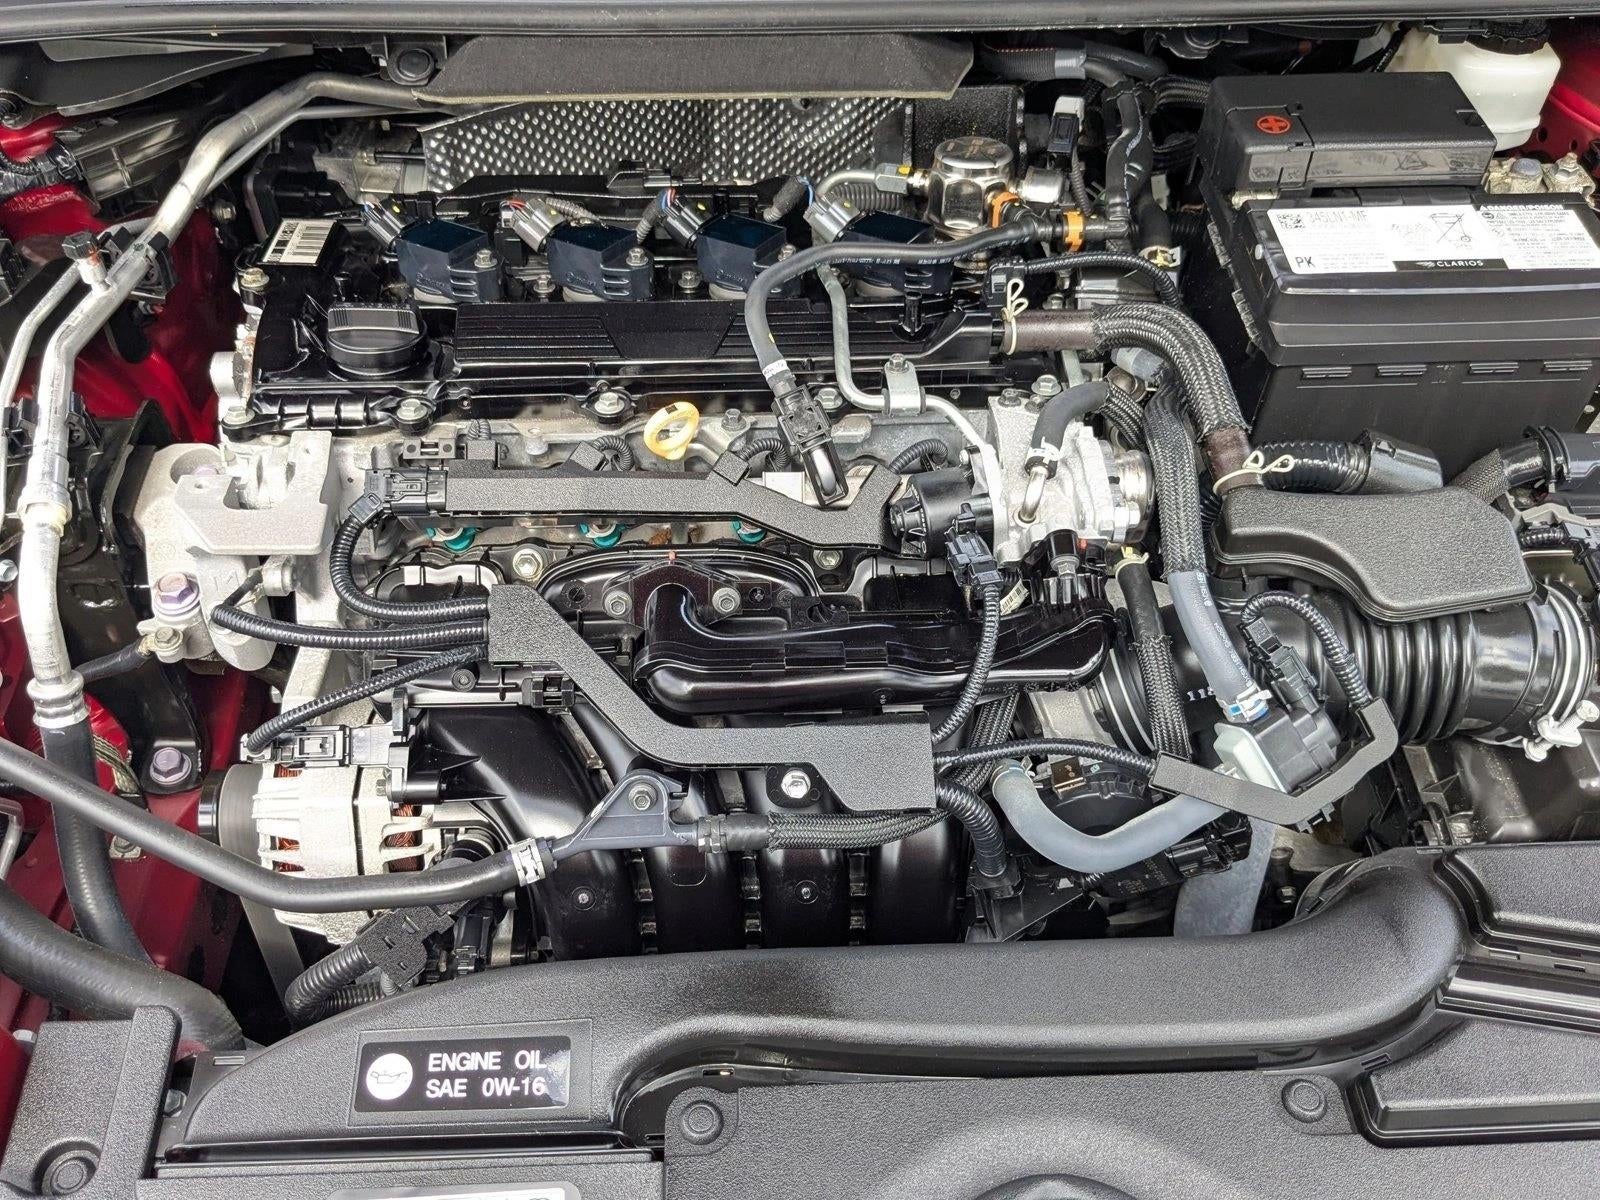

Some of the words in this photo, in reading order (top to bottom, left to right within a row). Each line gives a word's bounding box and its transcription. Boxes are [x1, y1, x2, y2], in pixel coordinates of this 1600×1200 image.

[1295, 255, 1315, 269] PK
[1436, 259, 1484, 268] CLARIOS
[428, 1051, 502, 1072] ENGINE
[514, 1050, 547, 1070] OIL
[425, 1078, 468, 1099] SAE
[482, 1076, 546, 1097] 0W-16
